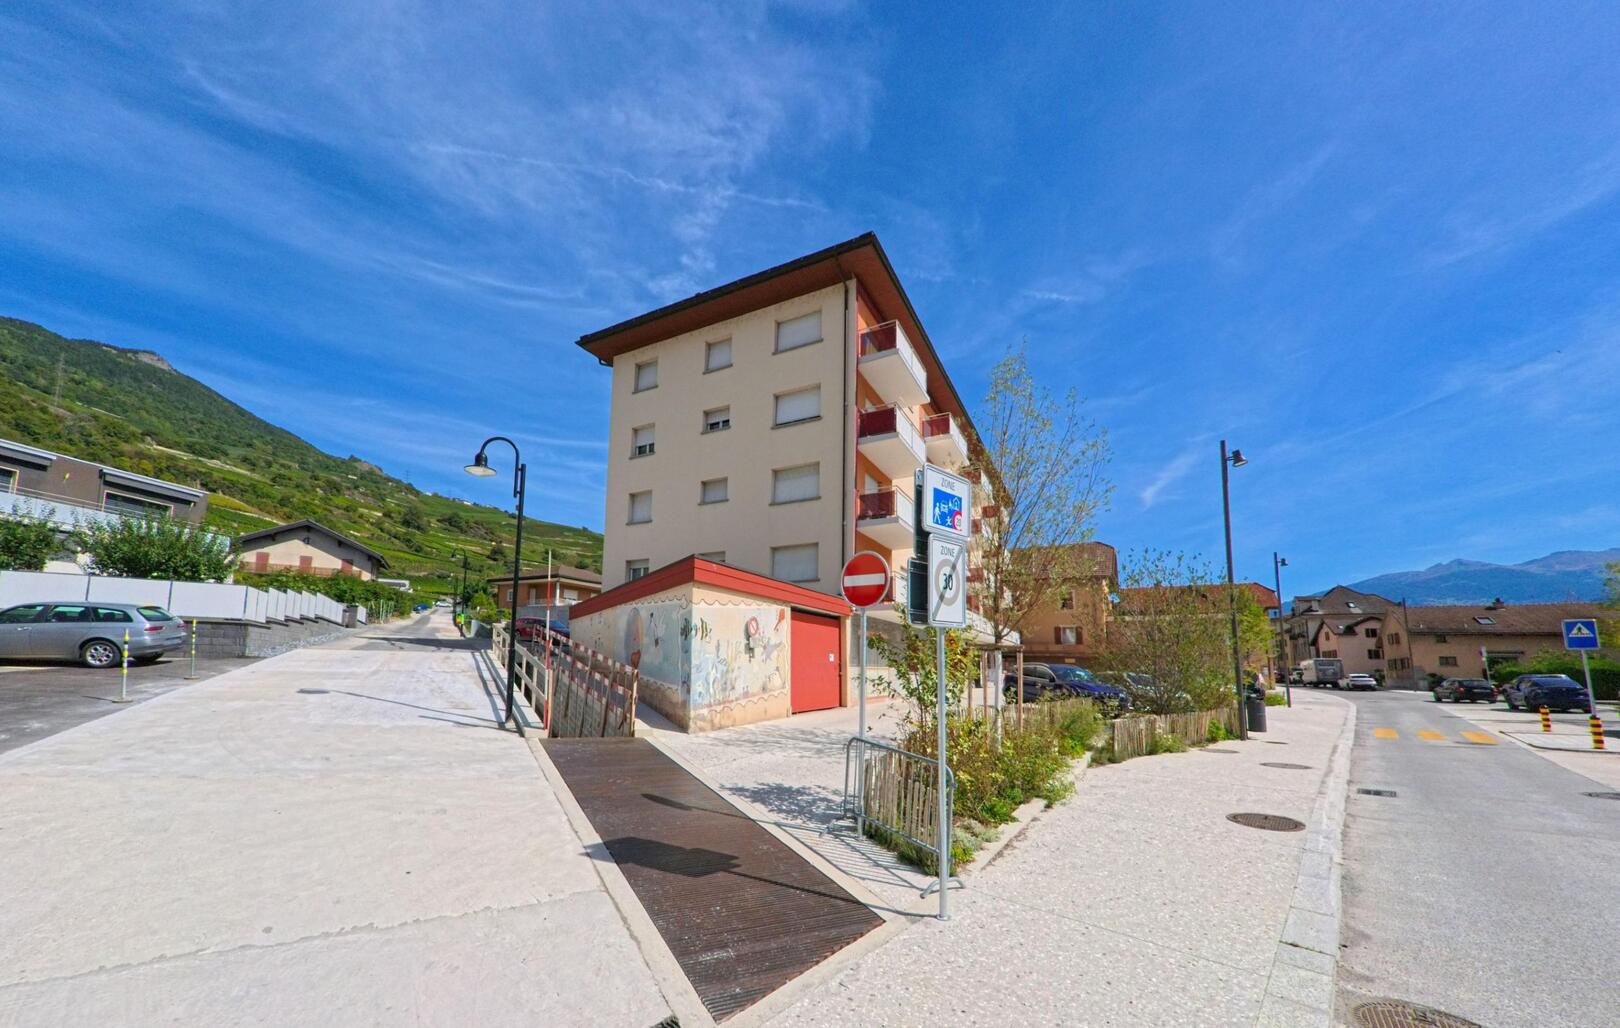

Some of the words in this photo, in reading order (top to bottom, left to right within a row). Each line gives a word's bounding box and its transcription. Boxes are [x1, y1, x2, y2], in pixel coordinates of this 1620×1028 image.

[941, 477, 955, 491] ZONE
[940, 545, 955, 557] ZONE
[943, 573, 953, 591] 30
